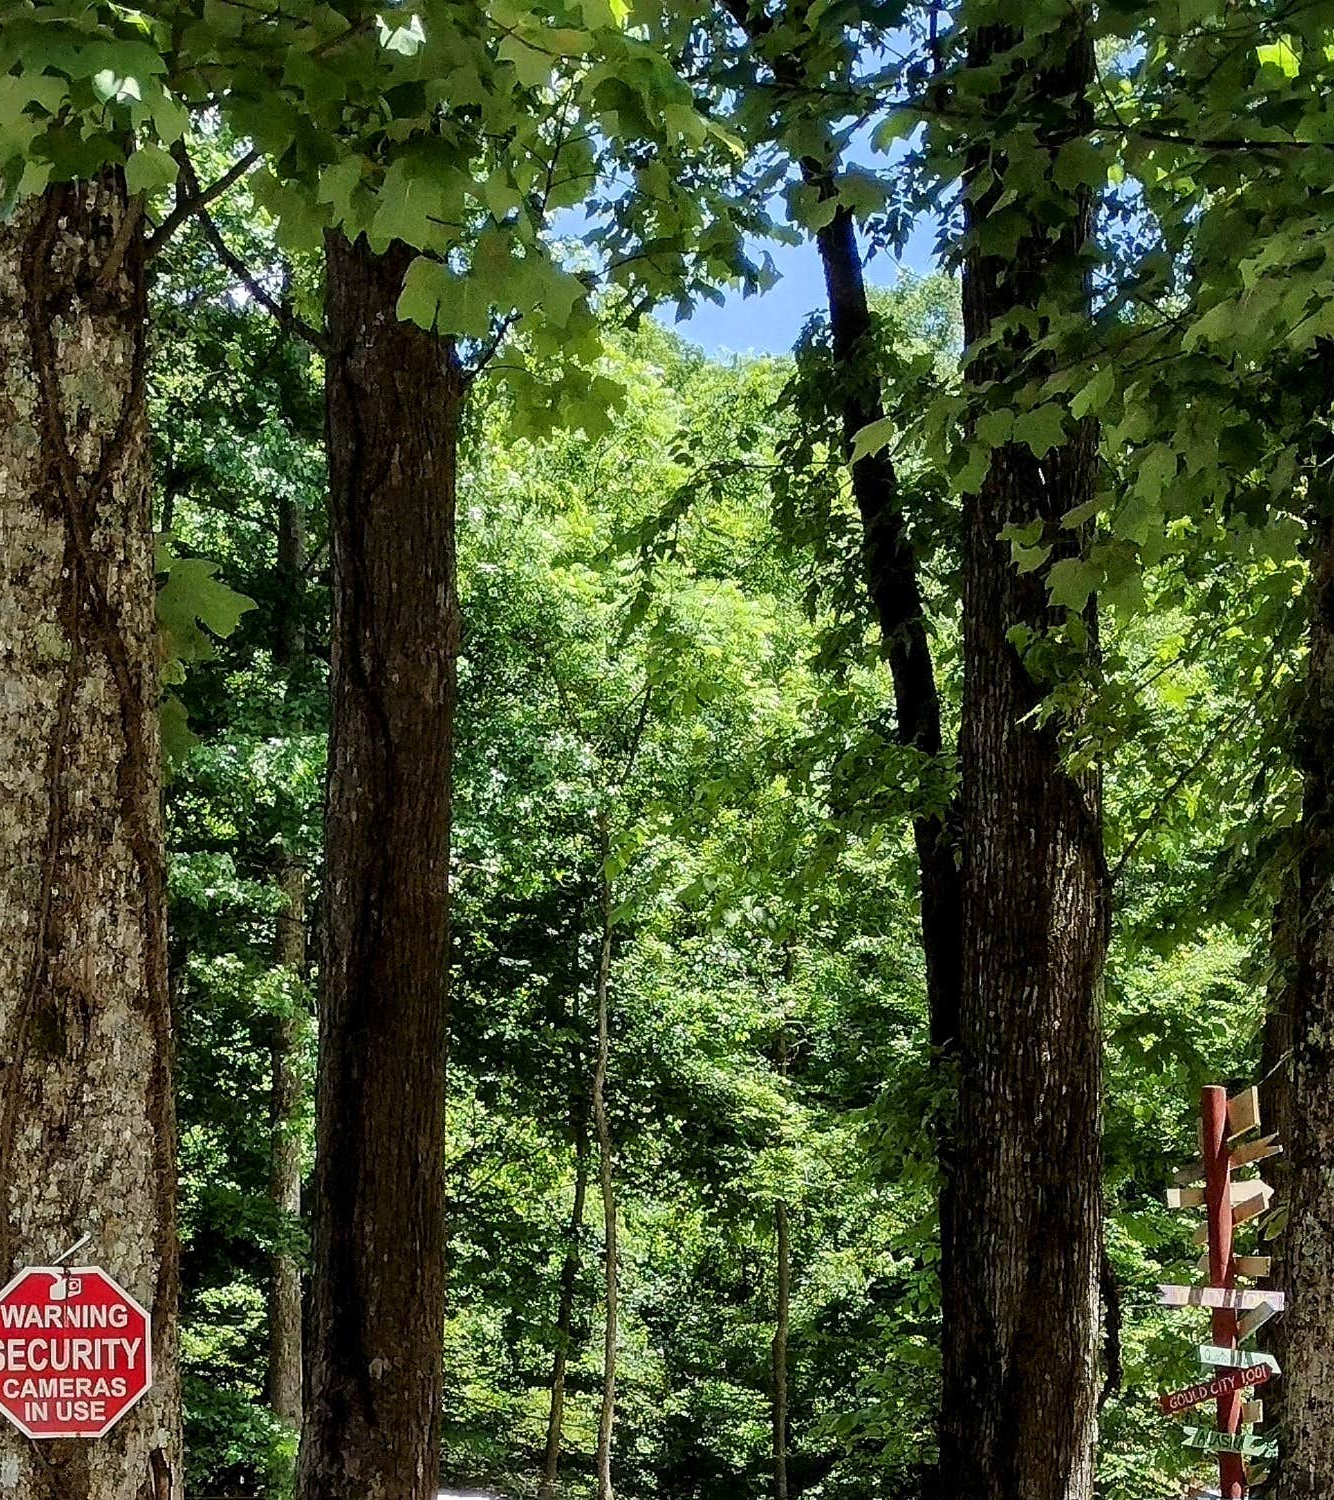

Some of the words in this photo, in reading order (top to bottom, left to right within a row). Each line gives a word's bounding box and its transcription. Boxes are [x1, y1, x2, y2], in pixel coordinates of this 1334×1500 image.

[0, 1304, 128, 1328] WARNING
[2, 1377, 127, 1399] CAMERAS
[1169, 1386, 1208, 1409] GOULD
[1210, 1375, 1236, 1394] CITY
[24, 1401, 47, 1422] IN
[56, 1401, 106, 1422] USE
